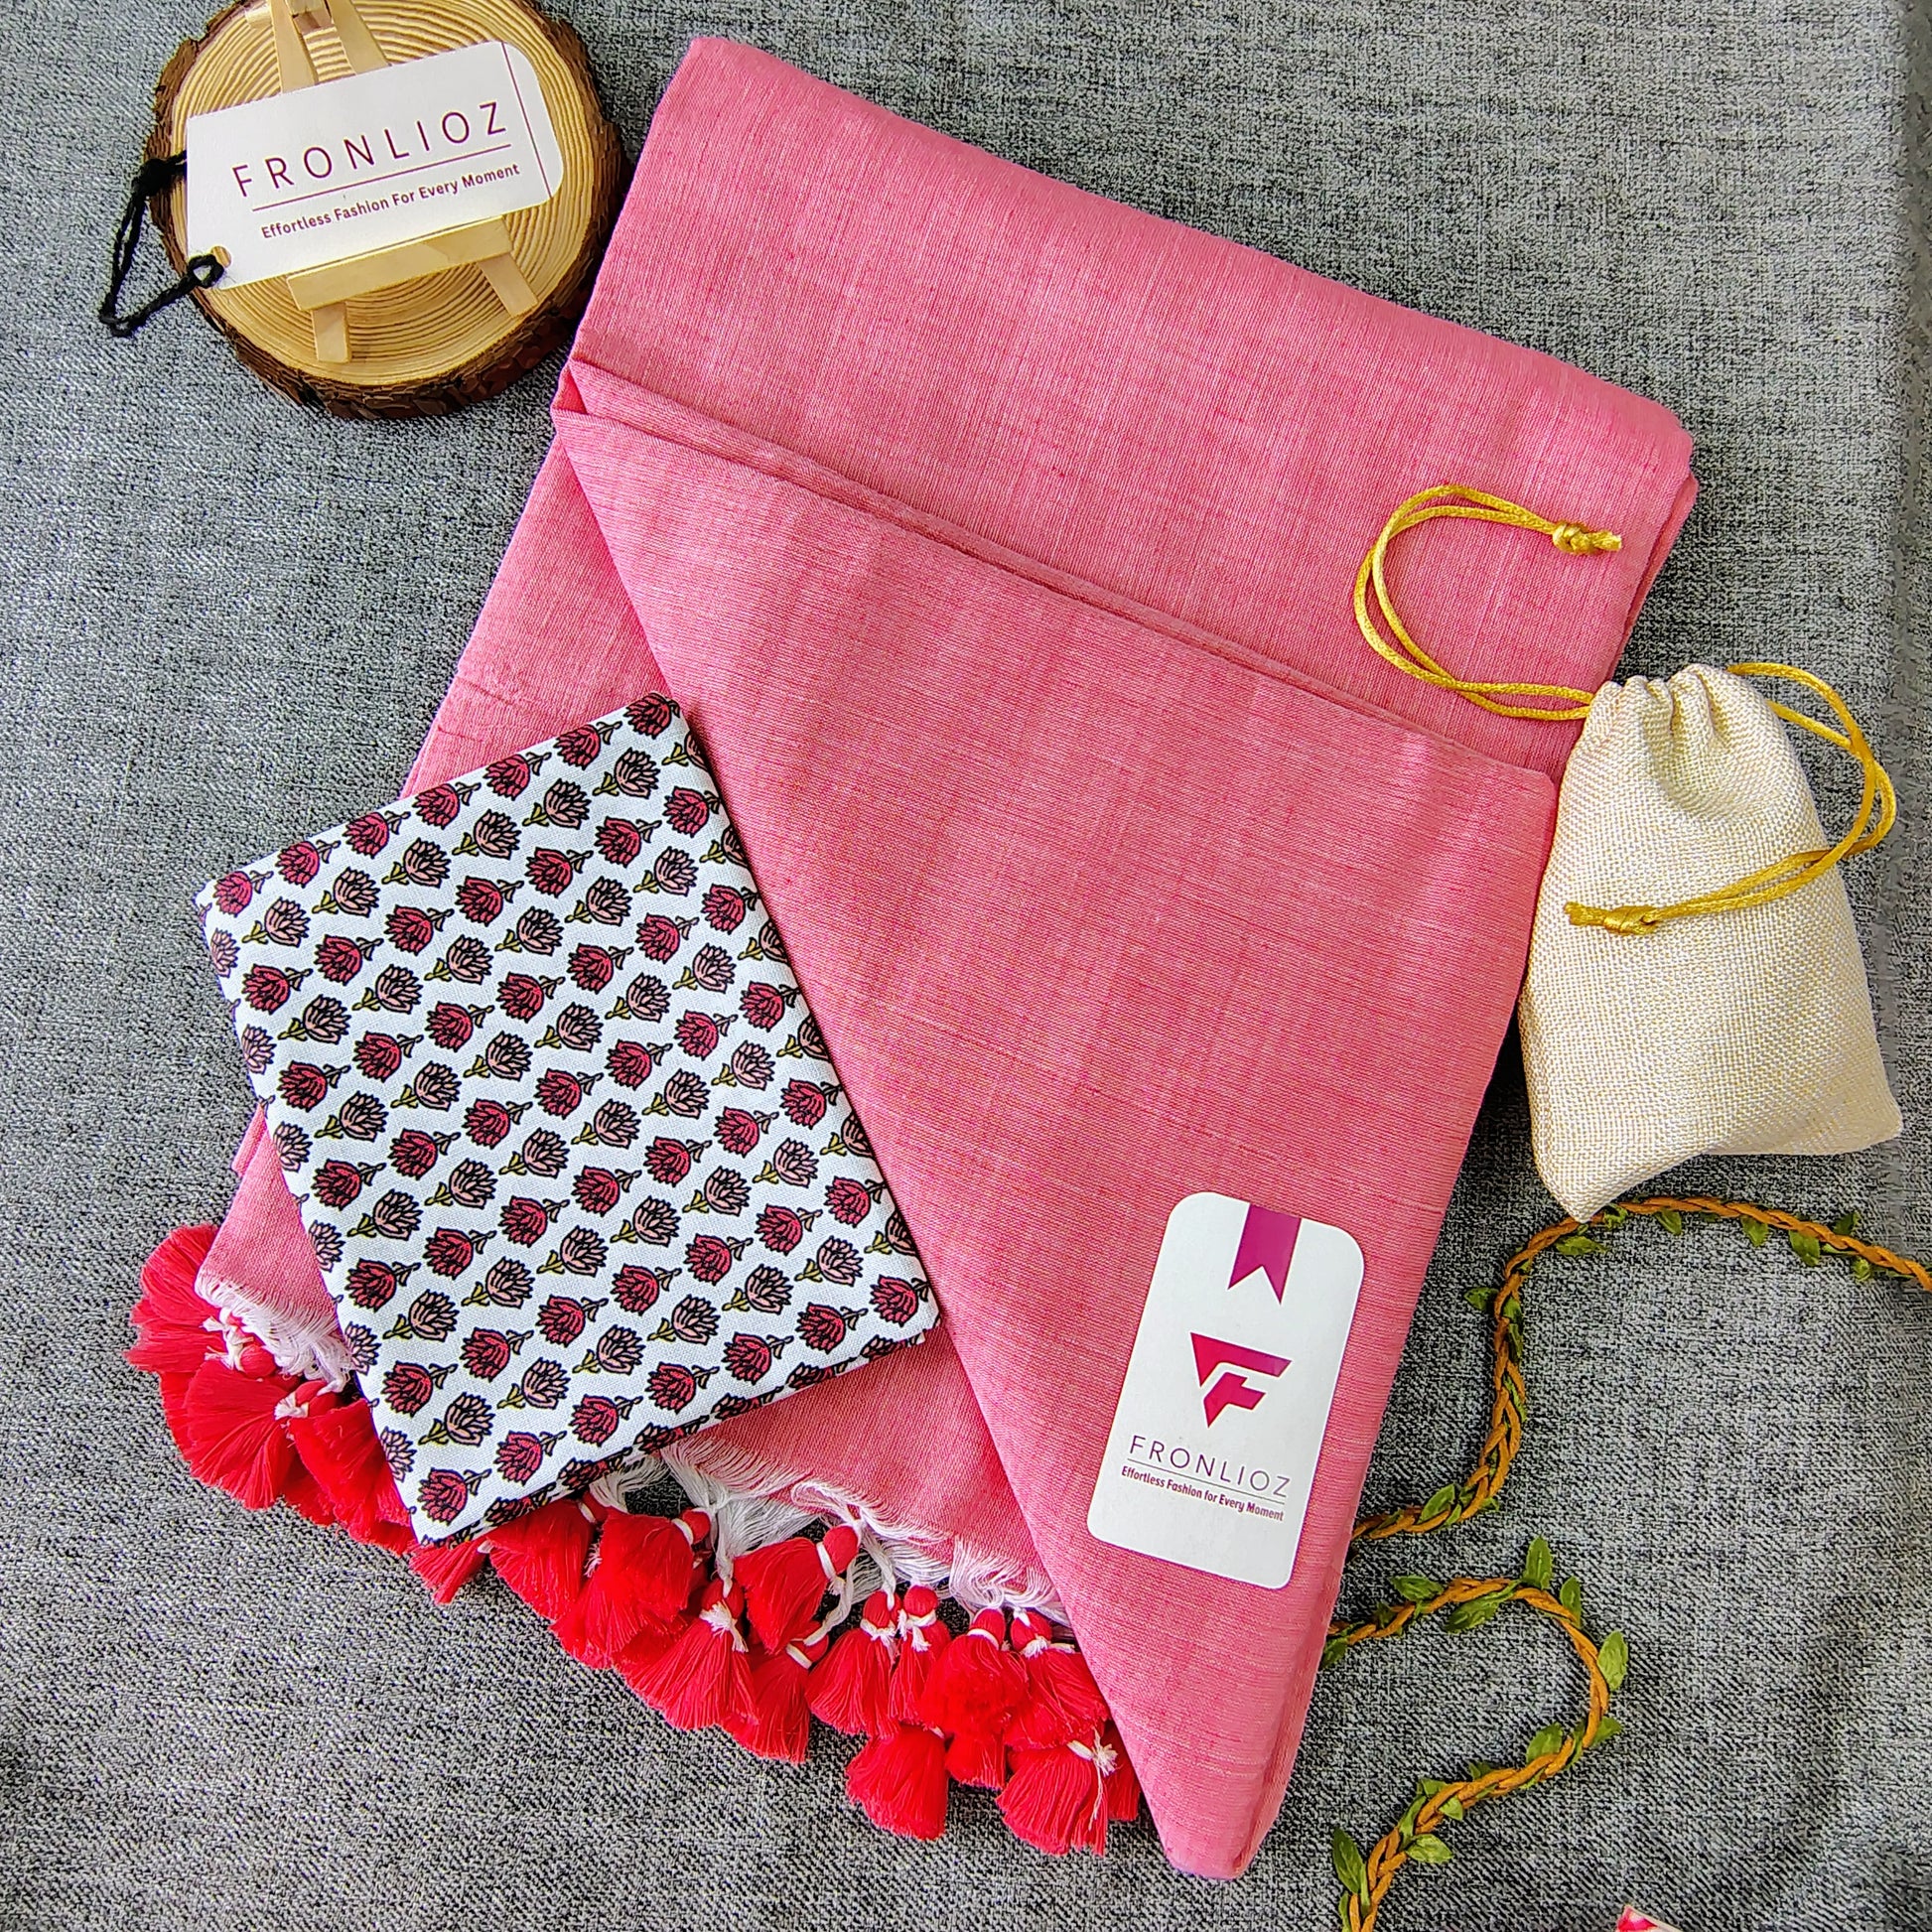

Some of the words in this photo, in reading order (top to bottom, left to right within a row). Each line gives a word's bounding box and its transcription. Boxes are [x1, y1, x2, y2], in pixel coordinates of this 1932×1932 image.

[231, 100, 506, 198] FRONLIOZ
[261, 211, 332, 239] Effortless
[334, 197, 390, 221] Fashion
[392, 184, 416, 207] For
[419, 180, 460, 199] Every
[462, 163, 520, 189] Moment
[1121, 1465, 1166, 1488] Effortless
[1167, 1479, 1202, 1500] Fashion
[1204, 1489, 1217, 1503] for
[1218, 1492, 1244, 1513] Every
[1246, 1501, 1285, 1521] Moment
[1129, 1435, 1292, 1498] FRONLIOZ
